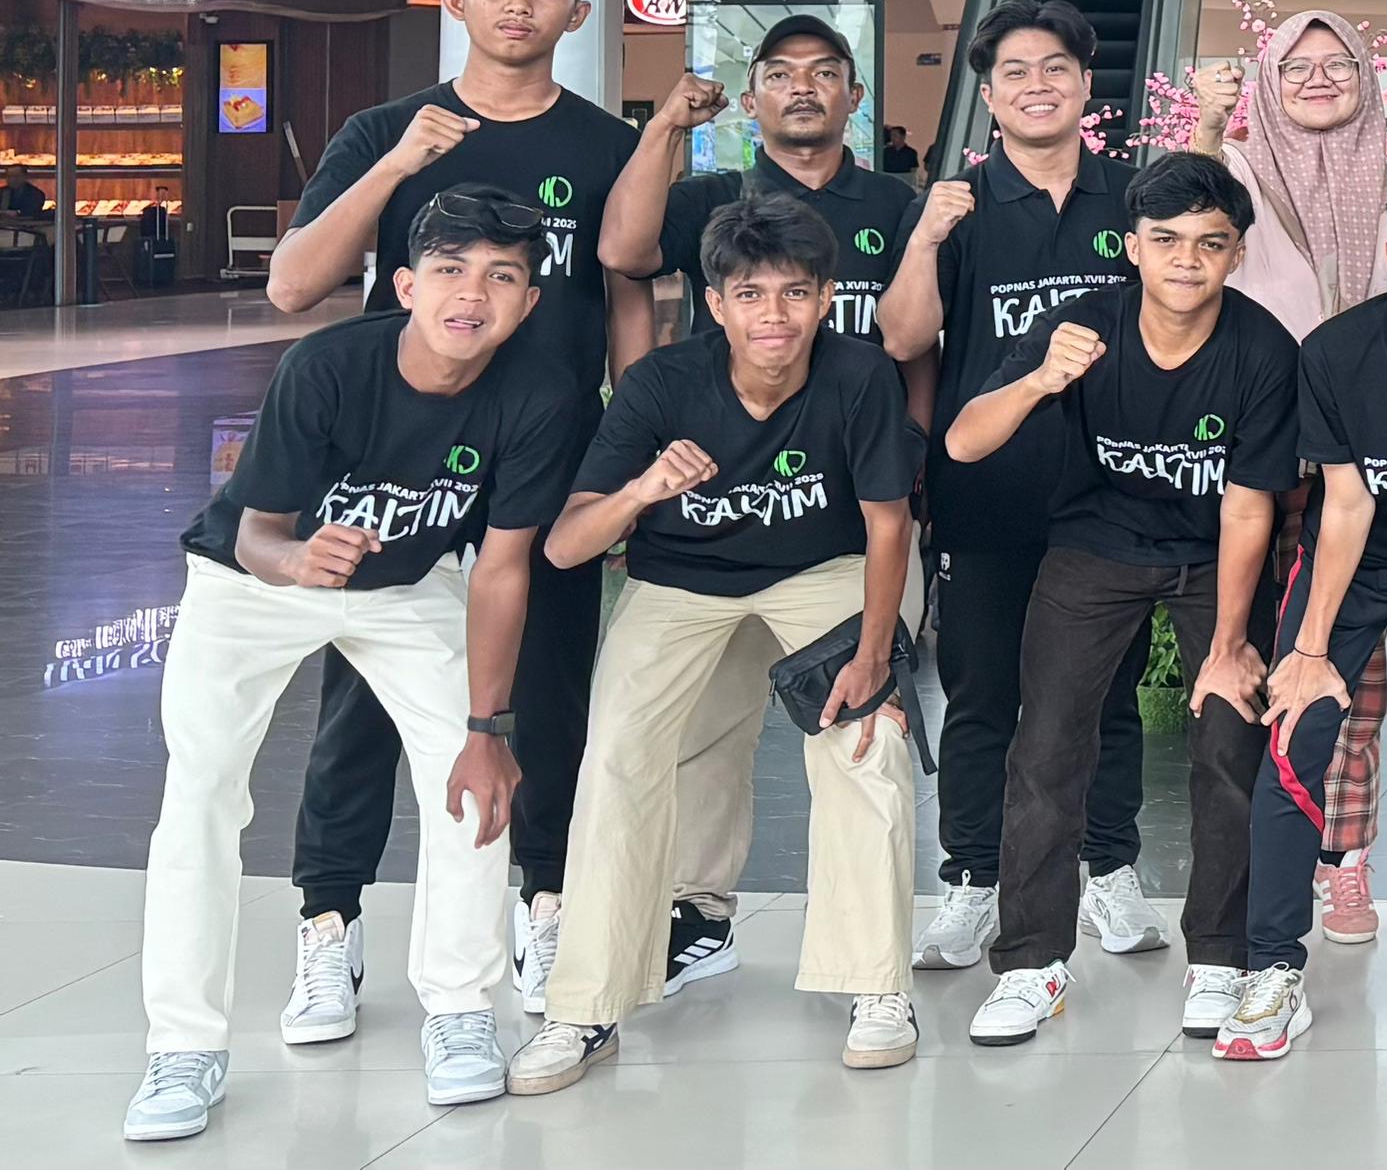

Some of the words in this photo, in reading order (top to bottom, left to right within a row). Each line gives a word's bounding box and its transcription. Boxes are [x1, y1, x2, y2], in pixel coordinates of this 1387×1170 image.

[990, 280, 1036, 294] POPNAS
[1037, 274, 1083, 288] JAKARTA
[1083, 274, 1105, 284] XVII
[1097, 443, 1225, 496] KALTIM
[681, 482, 828, 526] KALTIM
